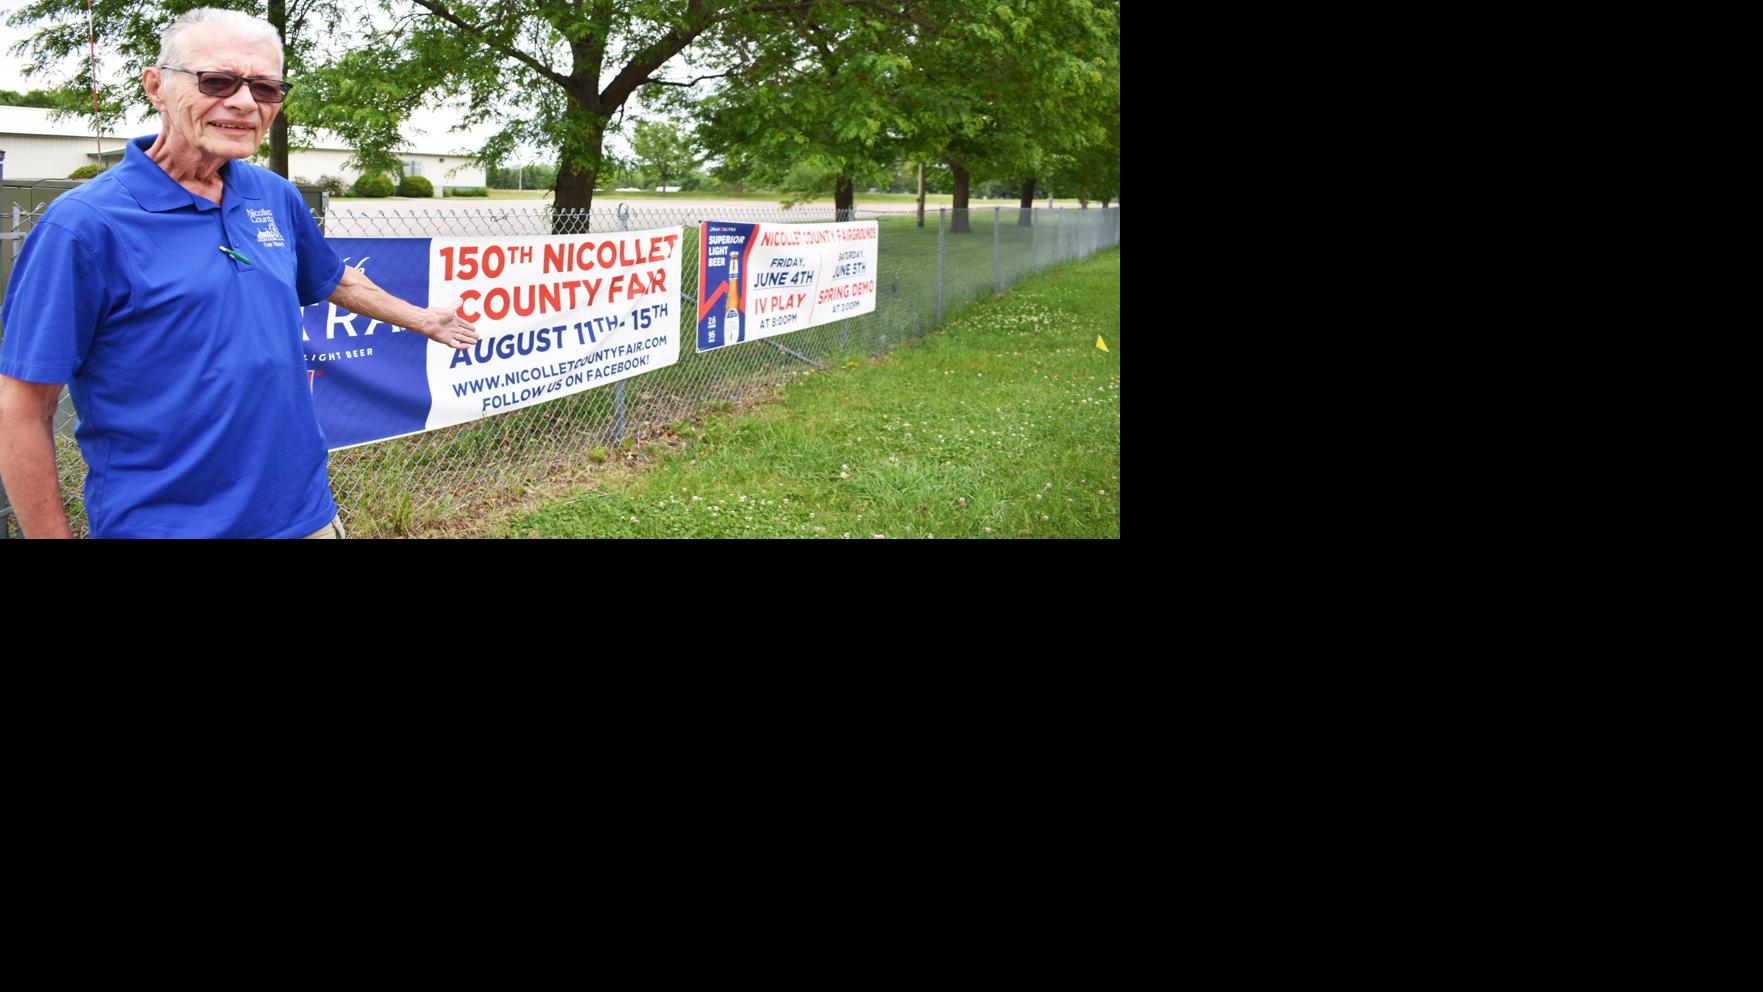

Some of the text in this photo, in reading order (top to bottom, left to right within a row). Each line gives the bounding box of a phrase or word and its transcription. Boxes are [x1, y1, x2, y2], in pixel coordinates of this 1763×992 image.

[708, 235, 746, 245] SUPERIOR
[761, 232, 801, 246] NICOLLET
[440, 234, 678, 281] 150TH NICOLLET
[708, 246, 729, 256] LIGHT
[708, 257, 726, 267] BEER
[833, 262, 866, 278] JUNE 5TH
[754, 271, 814, 288] JUNE 4TH
[456, 268, 667, 324] COUNTY FAIR
[818, 280, 874, 304] SPRING DEMO
[755, 293, 806, 315] IV PLAY
[831, 304, 840, 313] AT
[759, 318, 770, 330] AT
[449, 325, 567, 369] AUGUST
[632, 303, 668, 330] 15TH
[345, 347, 373, 359] BEER
[452, 336, 667, 397] WWW.NICOLLETCOUNTYFAIR.COM
[482, 355, 650, 412] FOLLOW US ON FACEBOOK!
